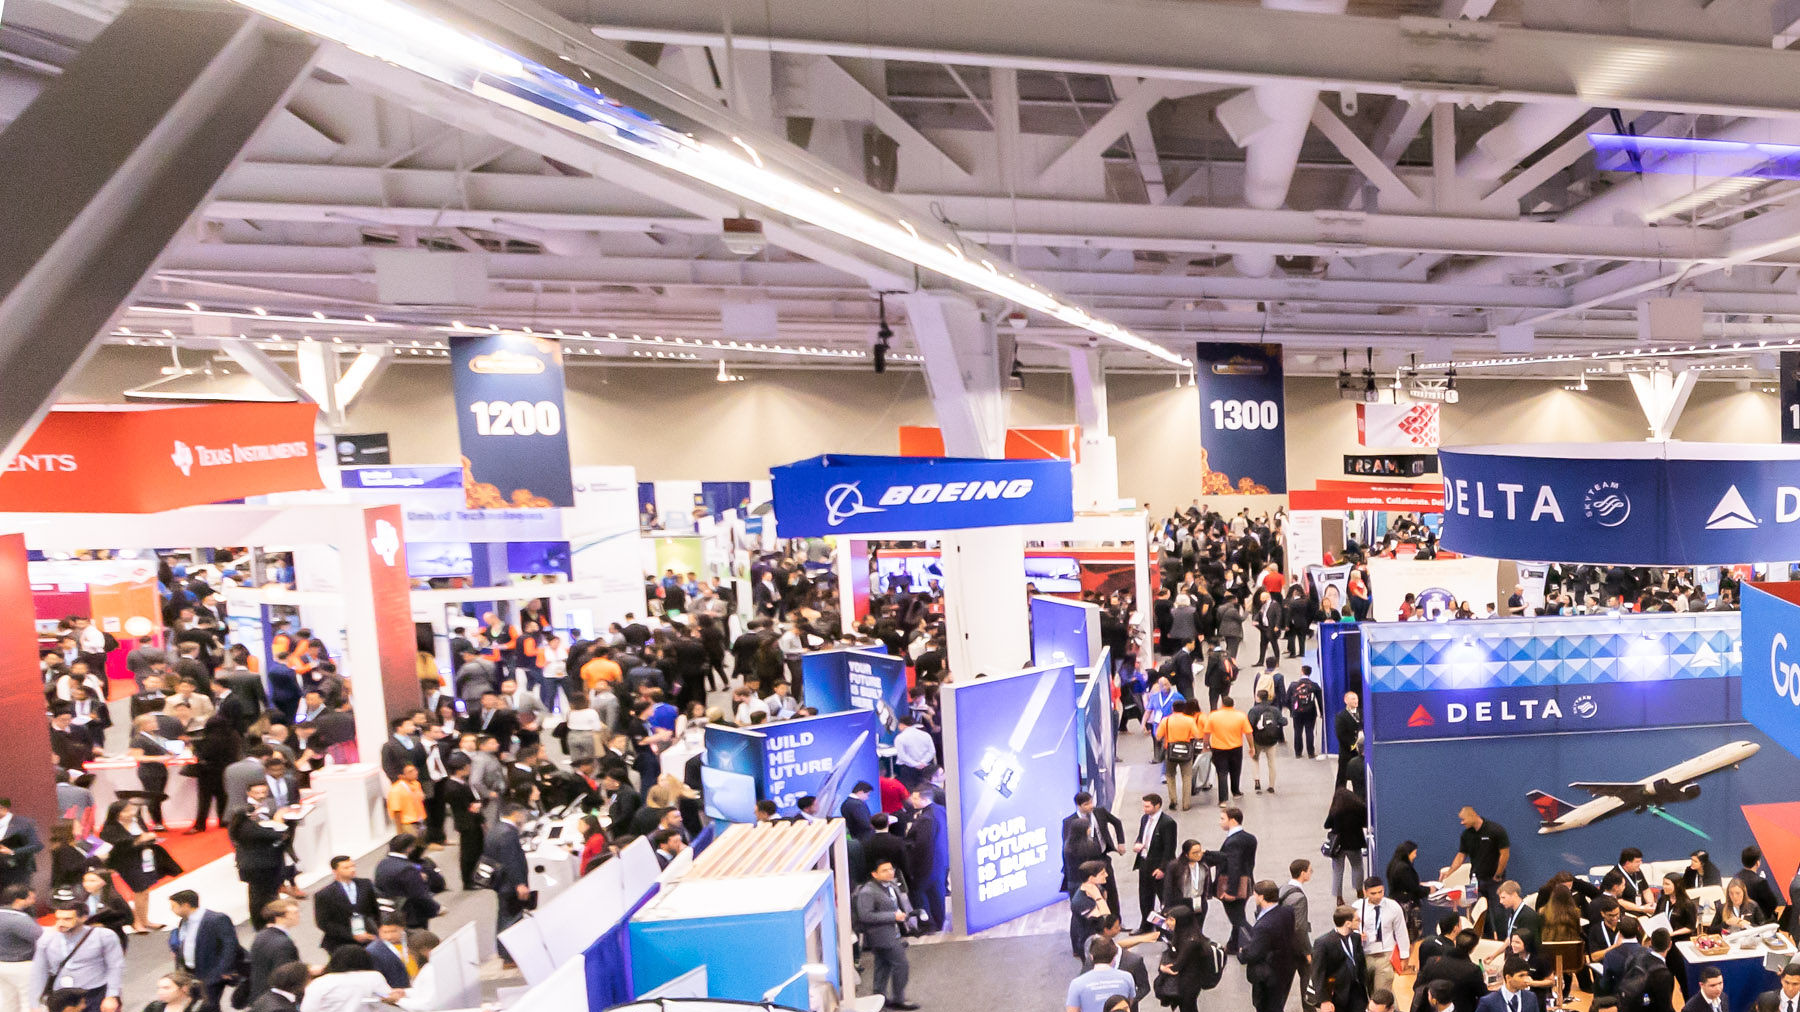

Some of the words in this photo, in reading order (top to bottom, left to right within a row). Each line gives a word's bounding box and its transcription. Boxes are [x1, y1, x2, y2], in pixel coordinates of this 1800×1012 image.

[470, 400, 562, 436] 1200
[1210, 399, 1279, 430] 1300
[879, 478, 1034, 506] BOEING
[1443, 476, 1565, 523] DELTA
[1584, 481, 1620, 518] SKYTEAM
[1447, 698, 1563, 724] DELTA
[976, 816, 1026, 846] YOUR
[977, 827, 1047, 866] FUTURE
